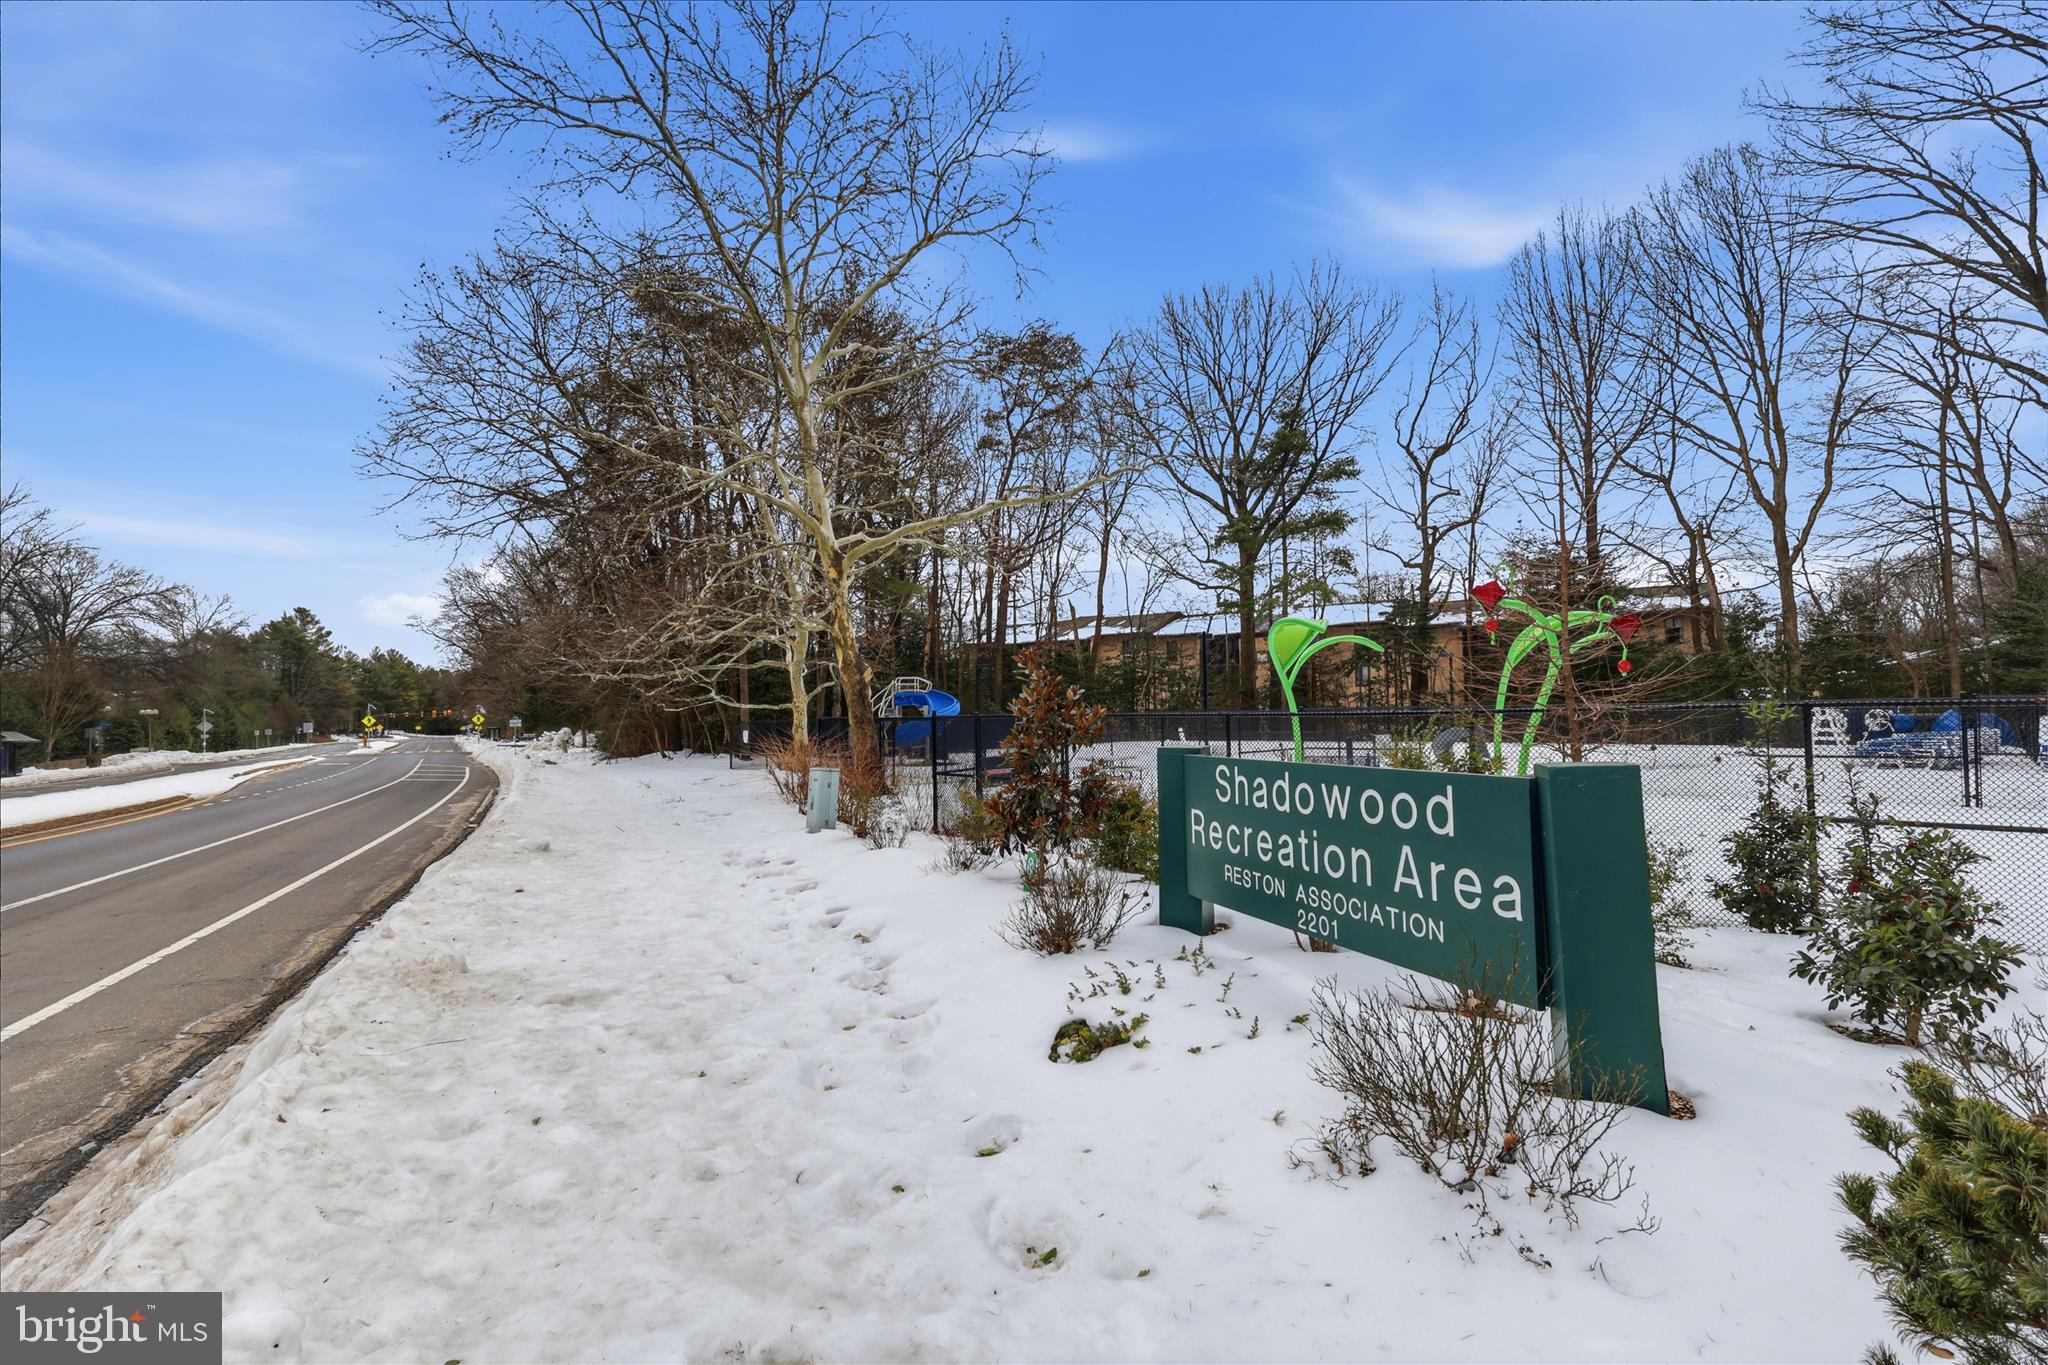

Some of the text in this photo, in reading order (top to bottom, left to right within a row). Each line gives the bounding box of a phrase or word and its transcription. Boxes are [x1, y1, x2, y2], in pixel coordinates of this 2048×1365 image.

[1215, 764, 1455, 837] Shadowood
[1191, 808, 1523, 922] Recreation Area
[1224, 864, 1444, 943] RESTON ASSOCIATION
[1297, 909, 1338, 940] 2201
